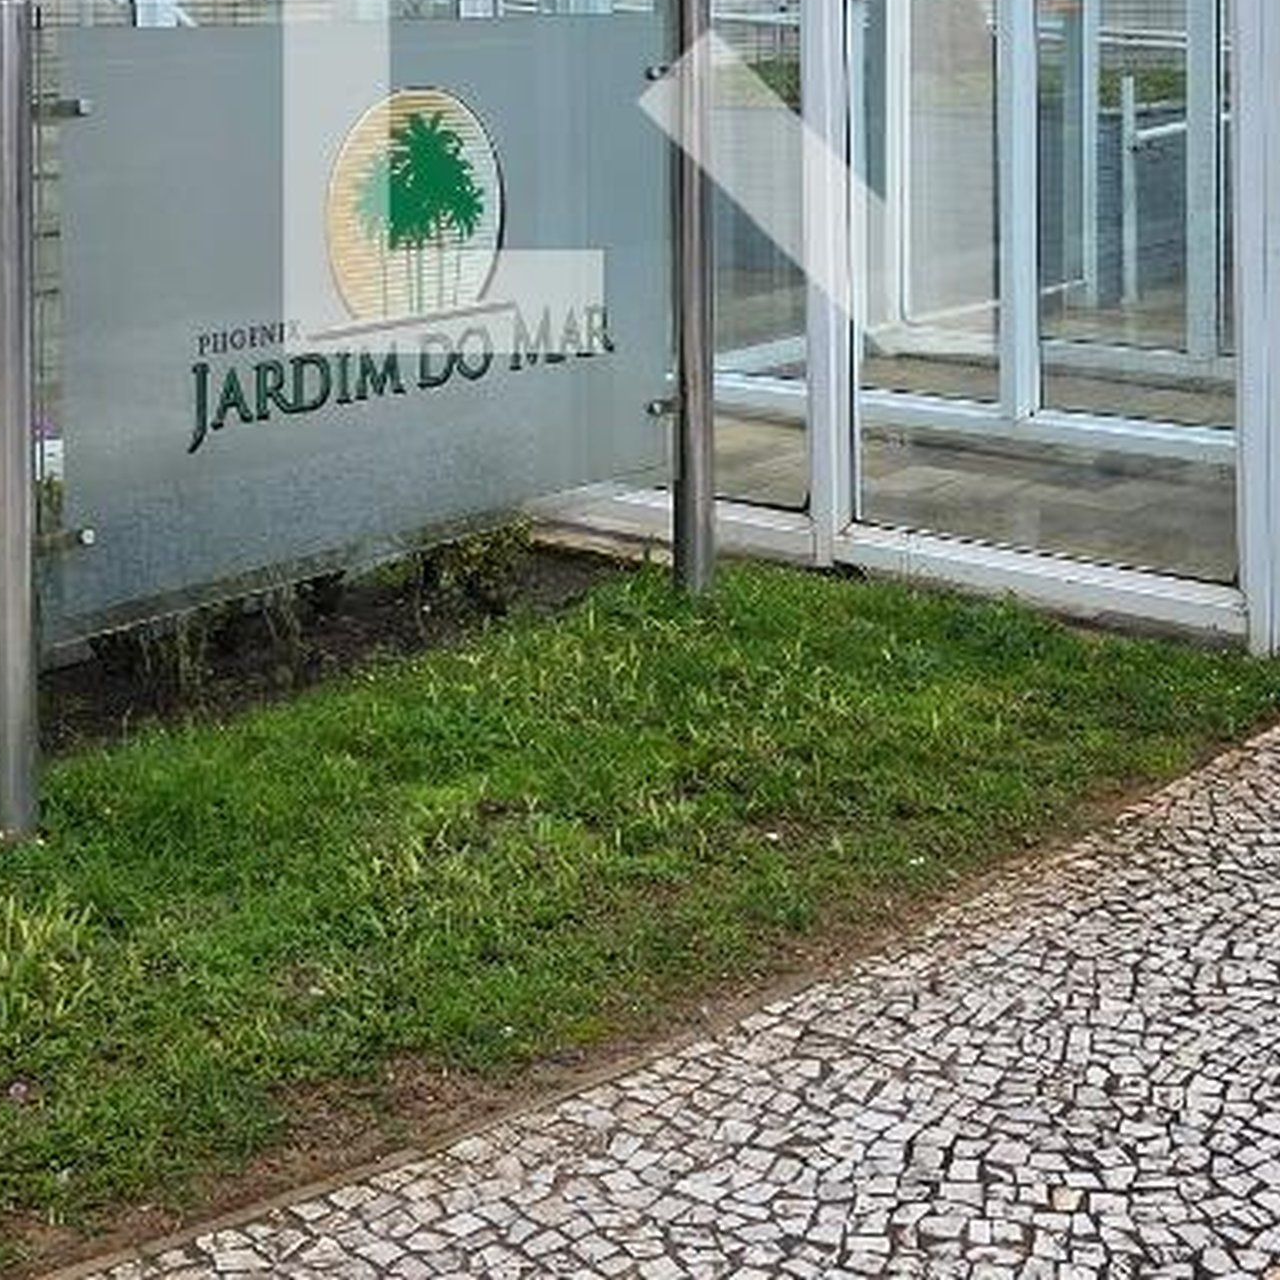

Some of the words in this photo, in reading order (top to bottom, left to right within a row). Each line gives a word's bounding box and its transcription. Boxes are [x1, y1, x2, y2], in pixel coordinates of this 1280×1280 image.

[188, 342, 407, 454] JARDIM
[417, 327, 493, 390] DO
[509, 304, 615, 372] MAR
